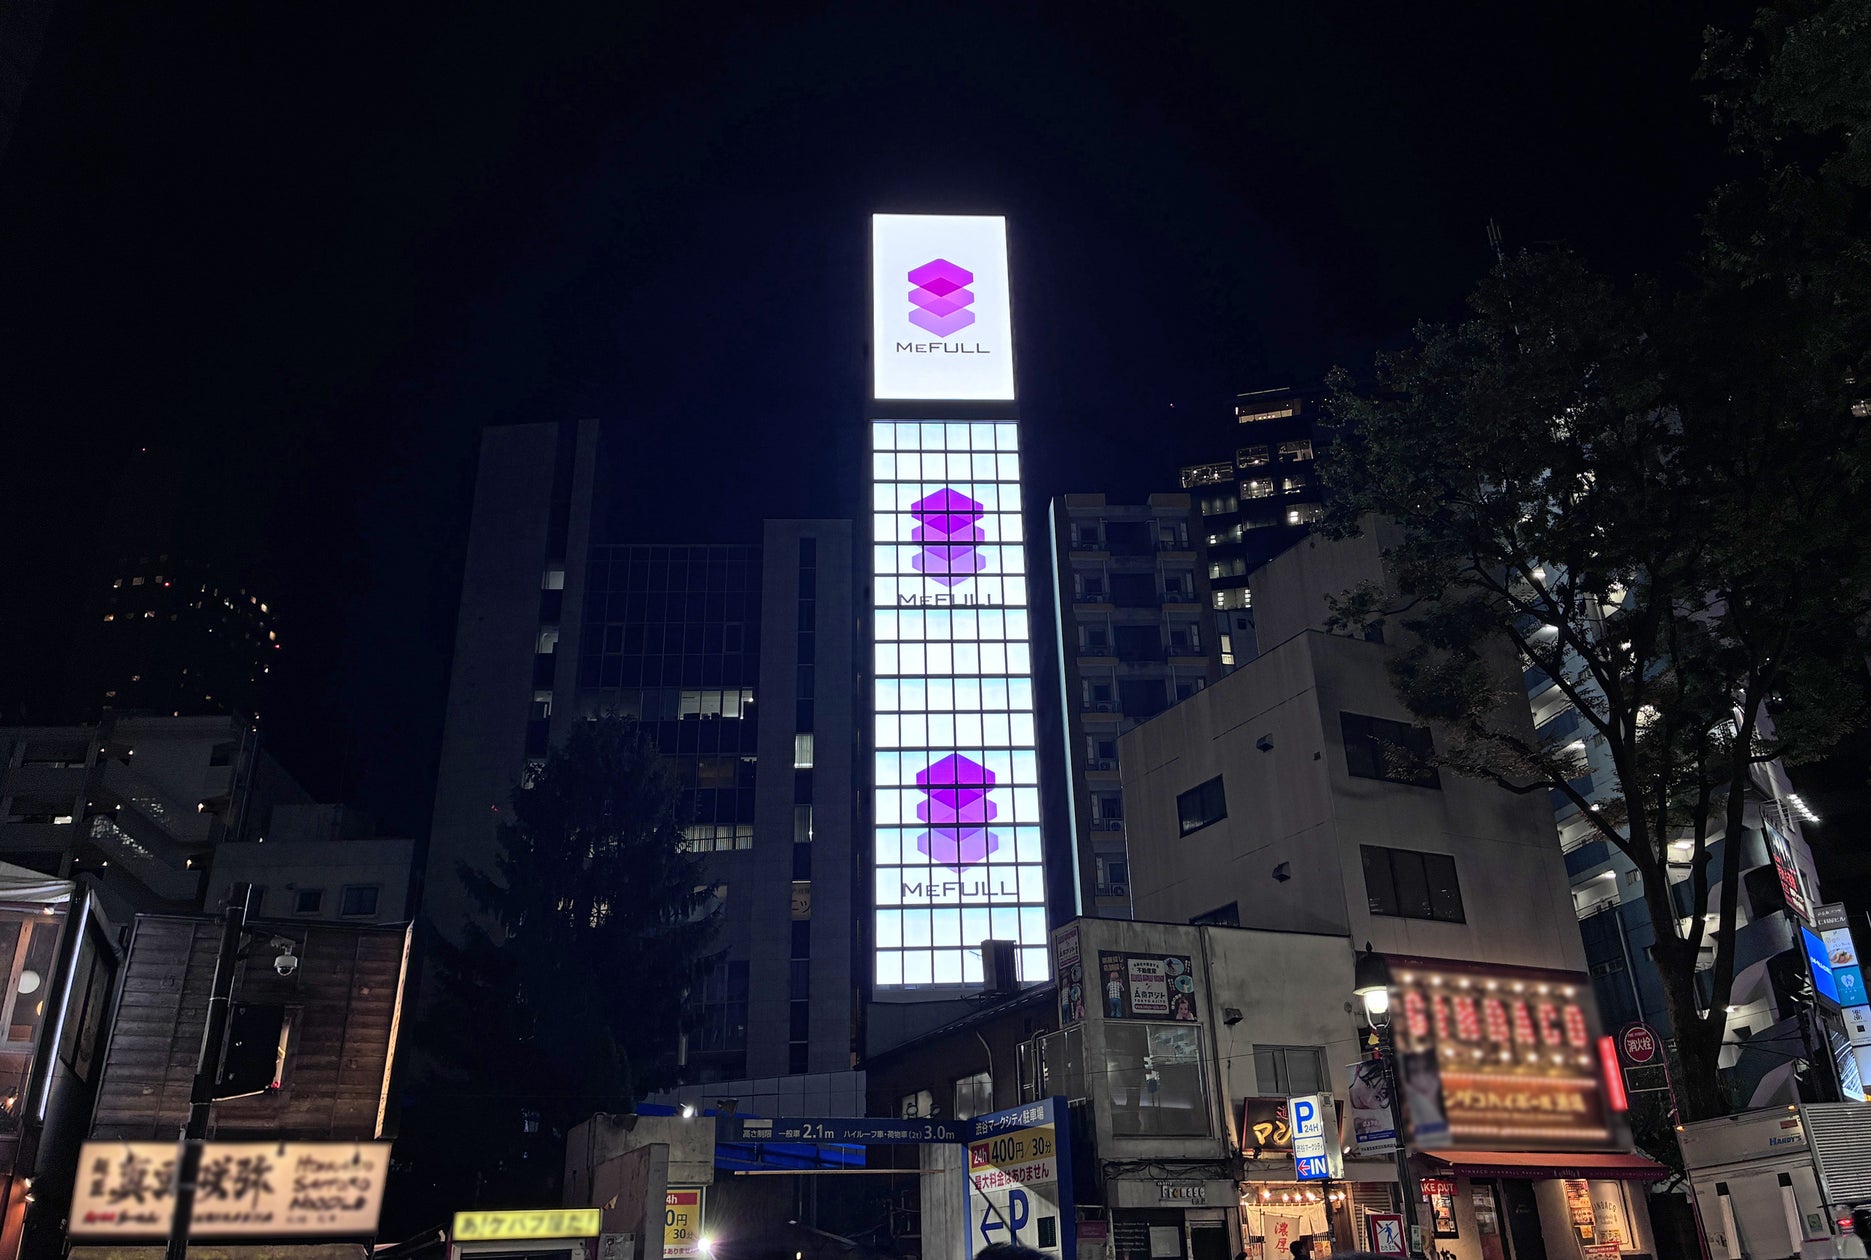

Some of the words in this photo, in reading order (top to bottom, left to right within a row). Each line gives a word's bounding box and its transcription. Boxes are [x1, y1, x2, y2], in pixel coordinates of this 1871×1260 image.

[1627, 1037, 1653, 1052] 消火栓
[975, 1106, 1044, 1136] 渋谷マークシティ駐車場
[1294, 1101, 1315, 1134] P
[742, 1129, 772, 1138] 高さ制限
[1304, 1123, 1319, 1133] 24H
[973, 1148, 988, 1164] 24h
[1309, 1158, 1327, 1175] IN
[974, 1163, 1050, 1190] 最大料金はありません
[1437, 1183, 1454, 1192] OUT
[666, 1194, 678, 1204] 4h
[666, 1209, 688, 1226] 0円
[1008, 1189, 1030, 1248] P
[1274, 1221, 1288, 1254] 濃厚
